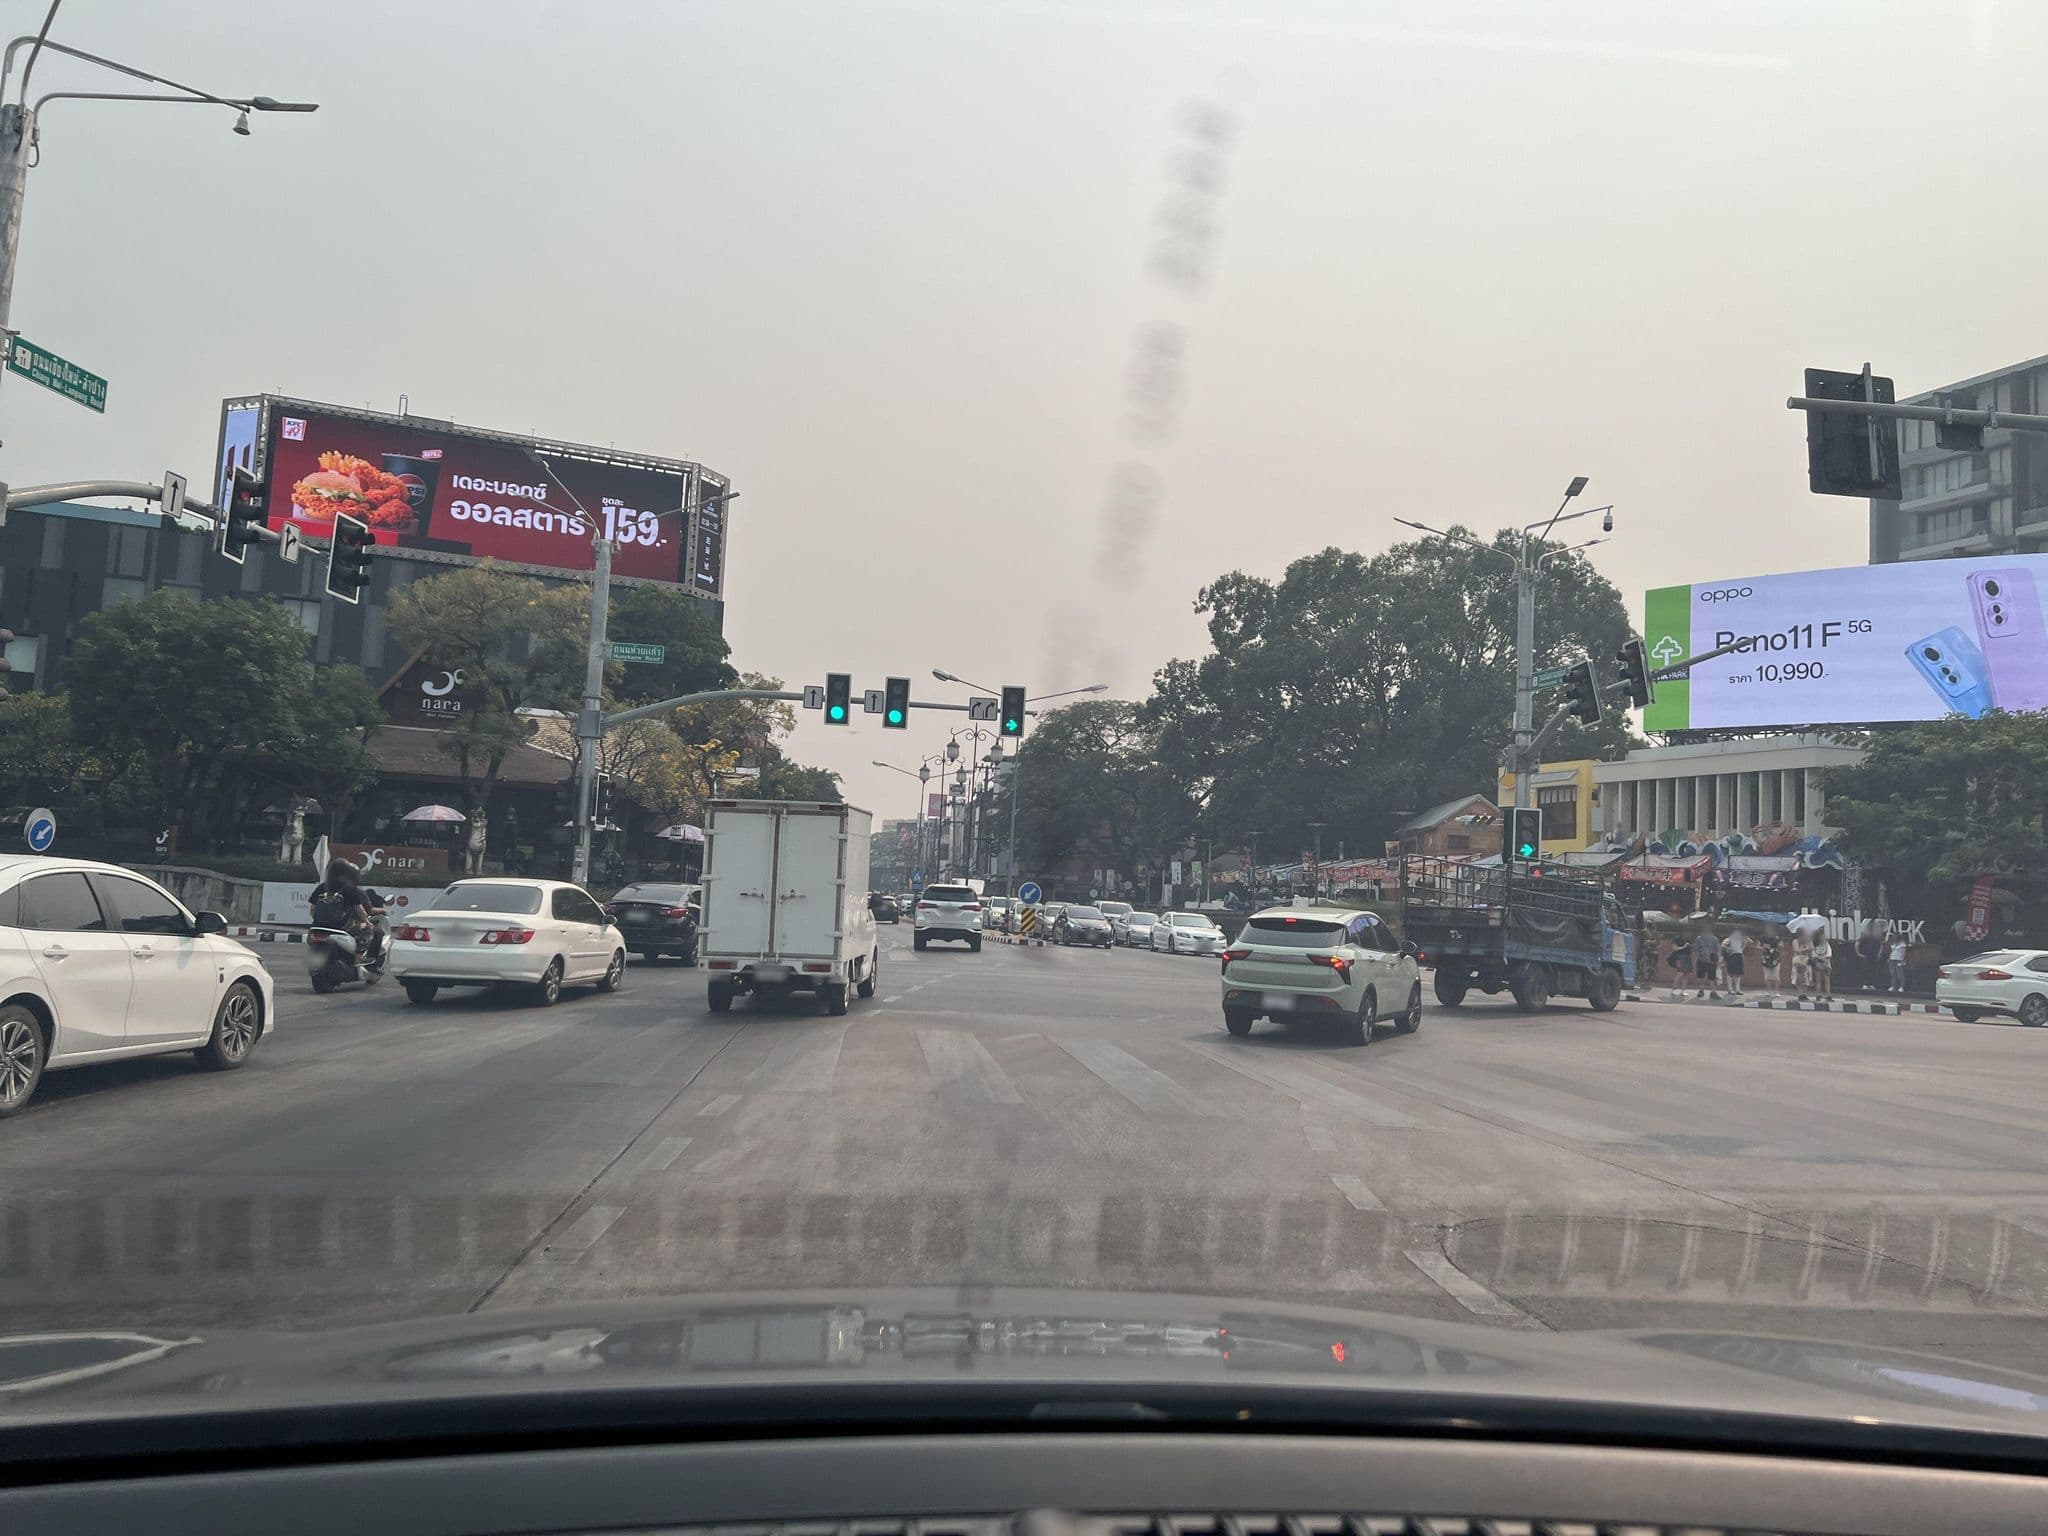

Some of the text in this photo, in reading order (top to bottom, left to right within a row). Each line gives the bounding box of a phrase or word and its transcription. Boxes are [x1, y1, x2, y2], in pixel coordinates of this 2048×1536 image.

[602, 496, 624, 506] ชุดละ
[450, 500, 586, 536] ออลสตาร์
[1716, 619, 1872, 654] Reno11 F 5G
[1728, 674, 1752, 684] ราคา
[422, 698, 461, 711] nara
